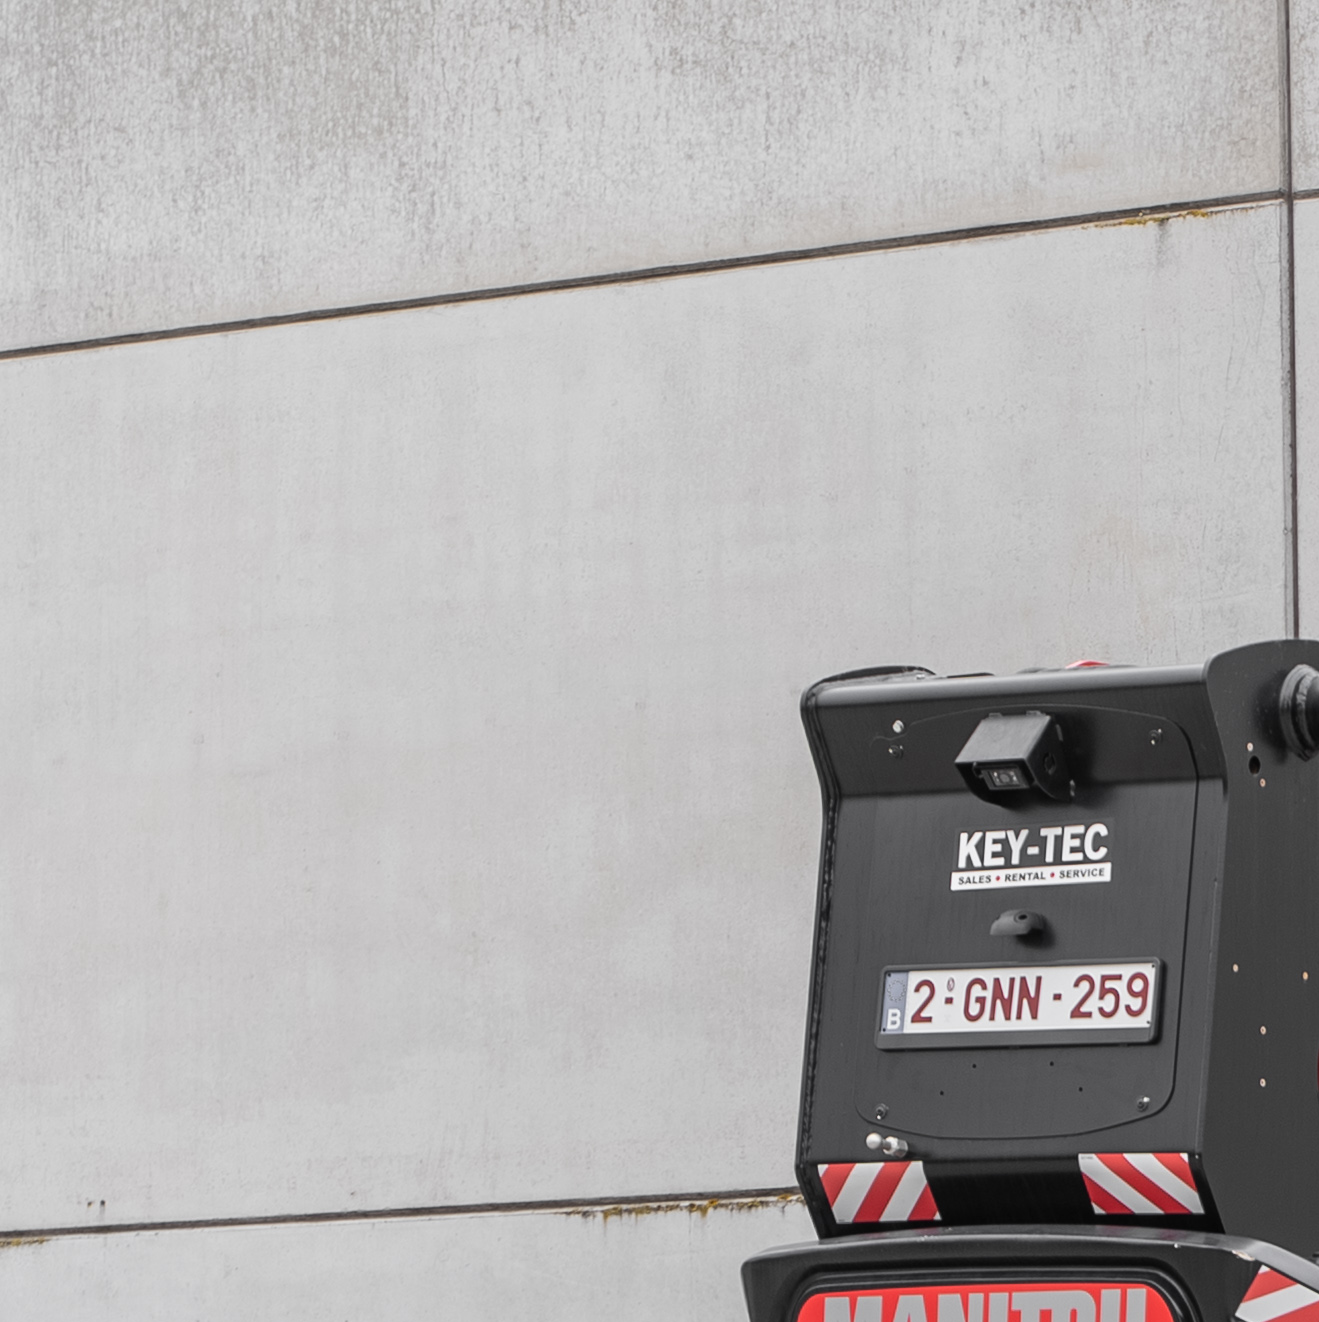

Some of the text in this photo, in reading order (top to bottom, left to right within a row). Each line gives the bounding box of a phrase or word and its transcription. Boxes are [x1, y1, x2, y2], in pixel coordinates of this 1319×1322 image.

[957, 823, 1109, 869] KEY-TEC
[958, 868, 1105, 885] SALES RENTAL SERVICE
[886, 1008, 901, 1030] B
